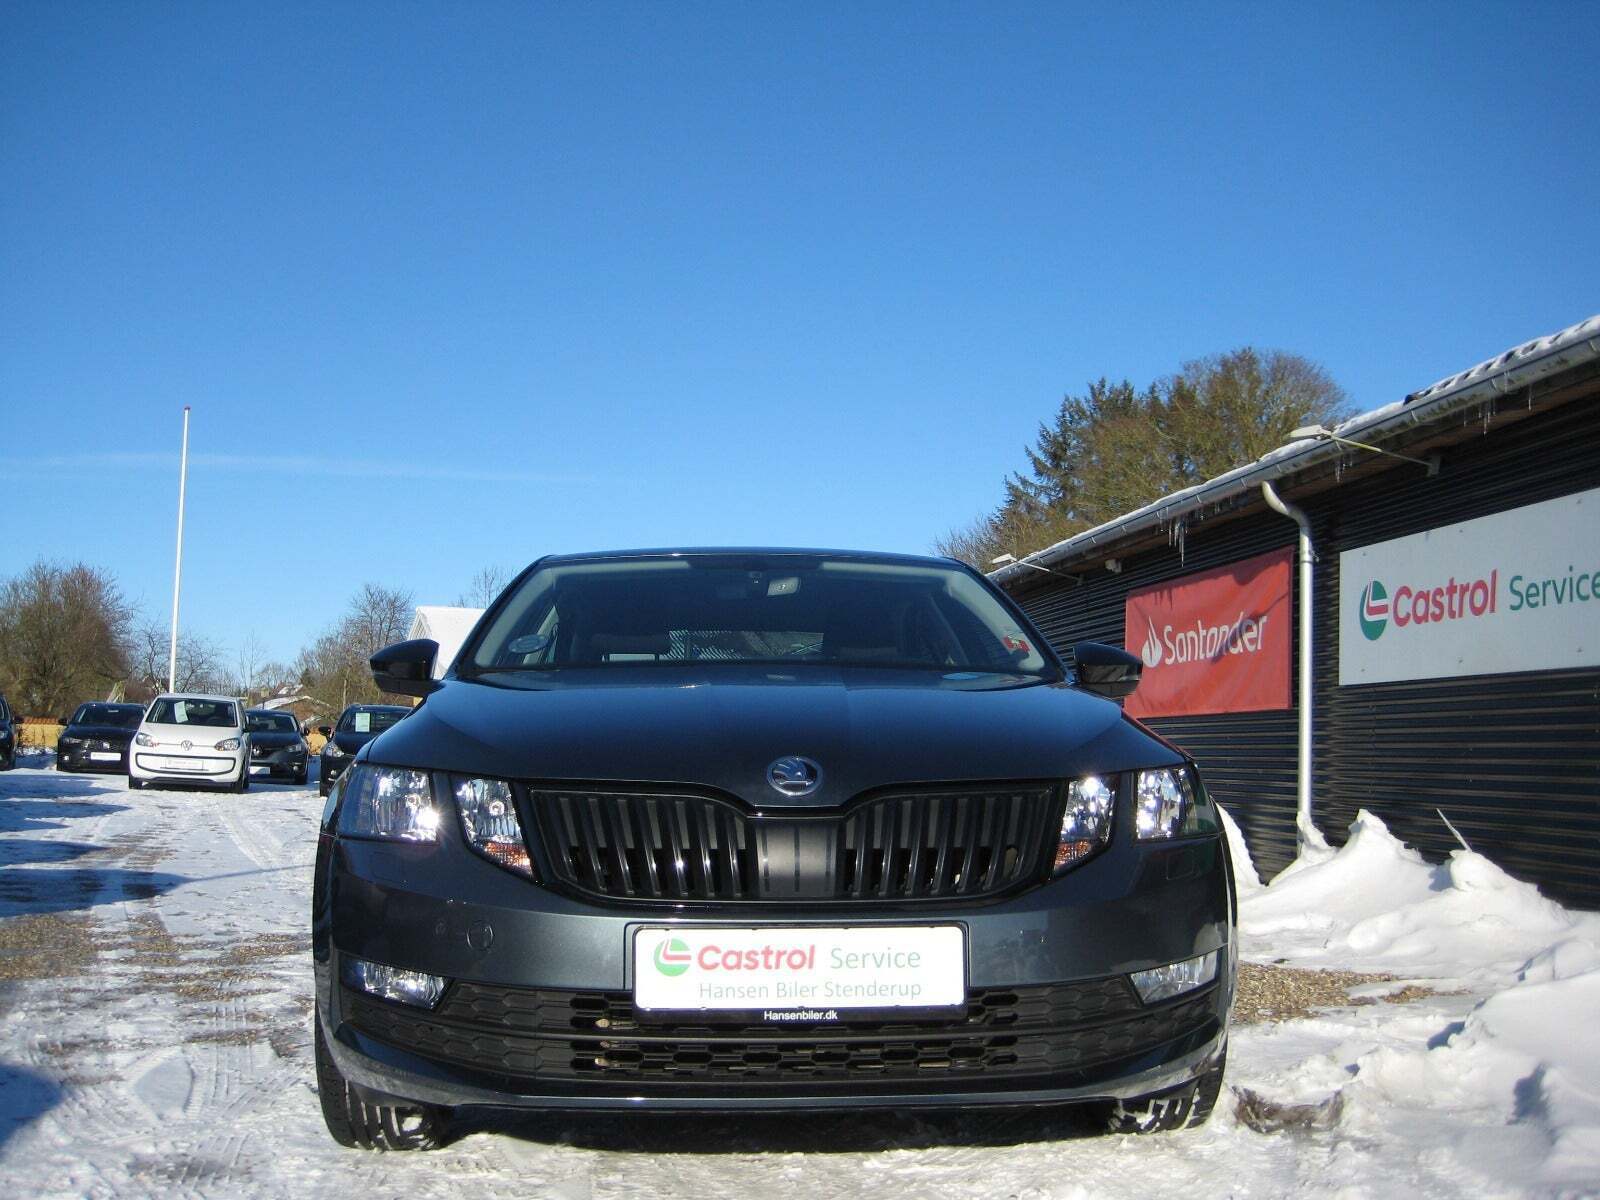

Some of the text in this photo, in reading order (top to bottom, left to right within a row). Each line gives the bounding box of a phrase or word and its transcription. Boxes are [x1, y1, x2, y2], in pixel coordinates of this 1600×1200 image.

[1393, 570, 1496, 627] Castrol
[1163, 611, 1267, 665] Santander
[698, 945, 921, 971] Castrol Service
[699, 981, 922, 999] Hansen Biler Stenderup
[763, 1009, 838, 1021] Hansenbiler.dk
